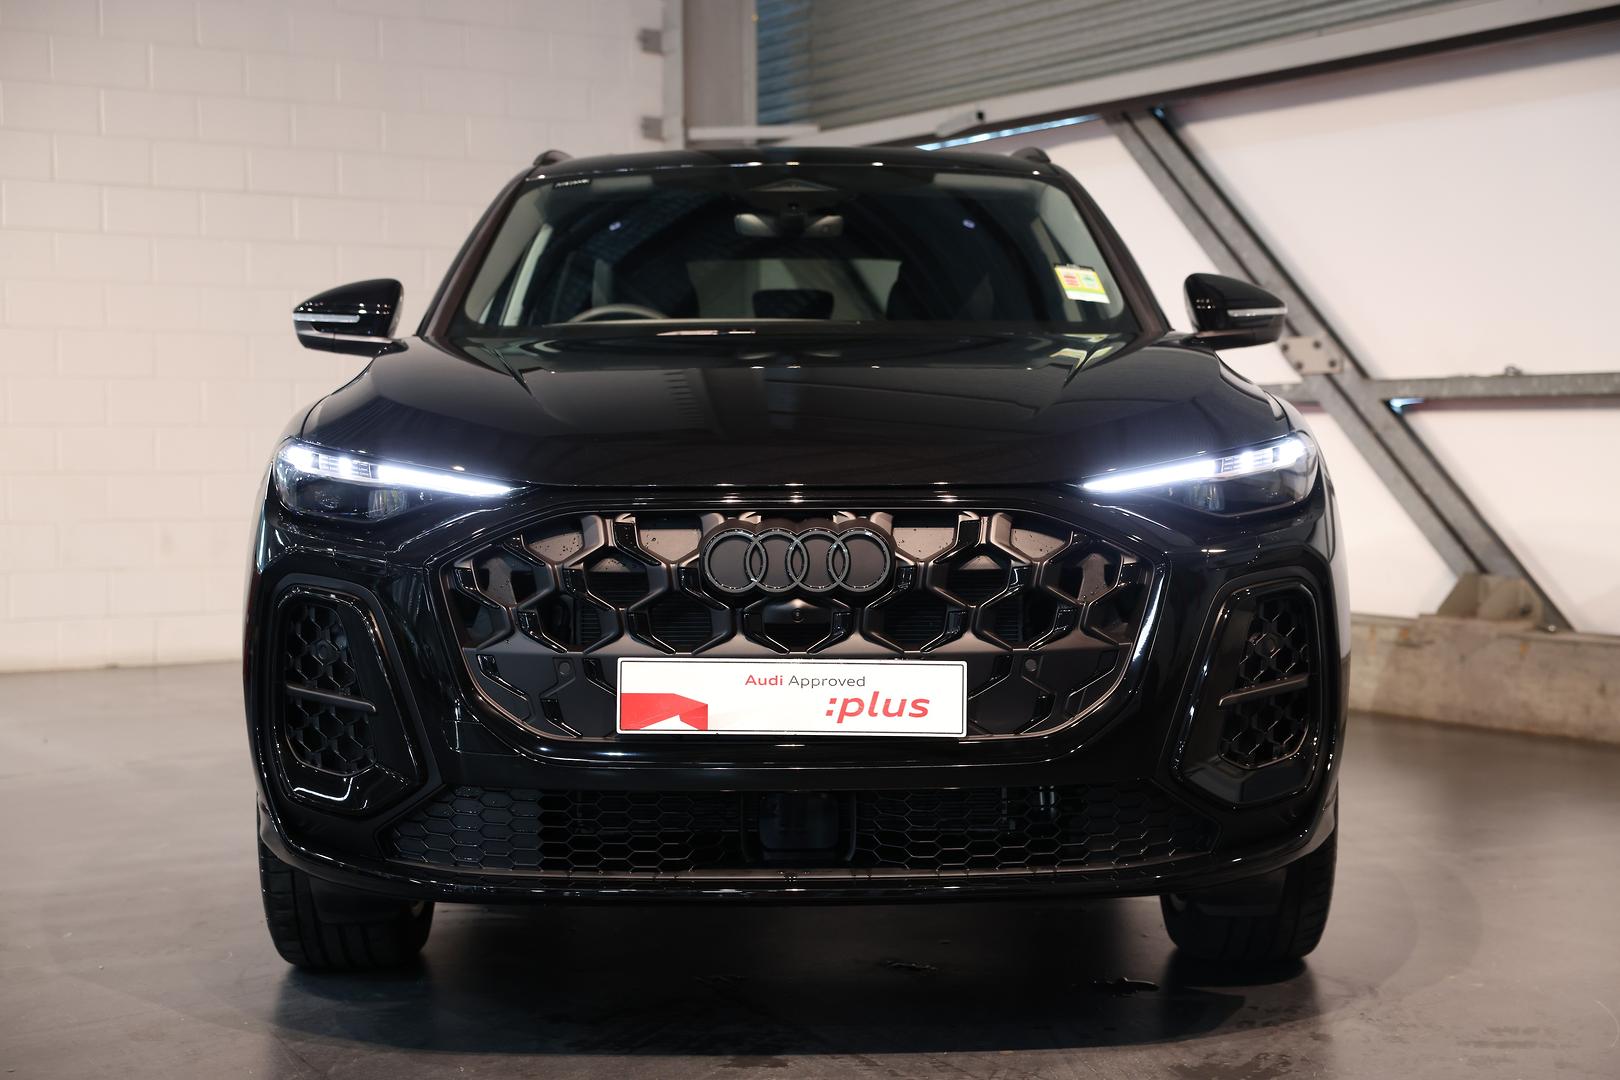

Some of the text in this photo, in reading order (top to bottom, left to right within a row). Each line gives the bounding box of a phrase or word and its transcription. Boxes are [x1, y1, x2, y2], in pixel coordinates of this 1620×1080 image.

[744, 674, 866, 689] Audi Approved
[825, 691, 930, 723] :plus
